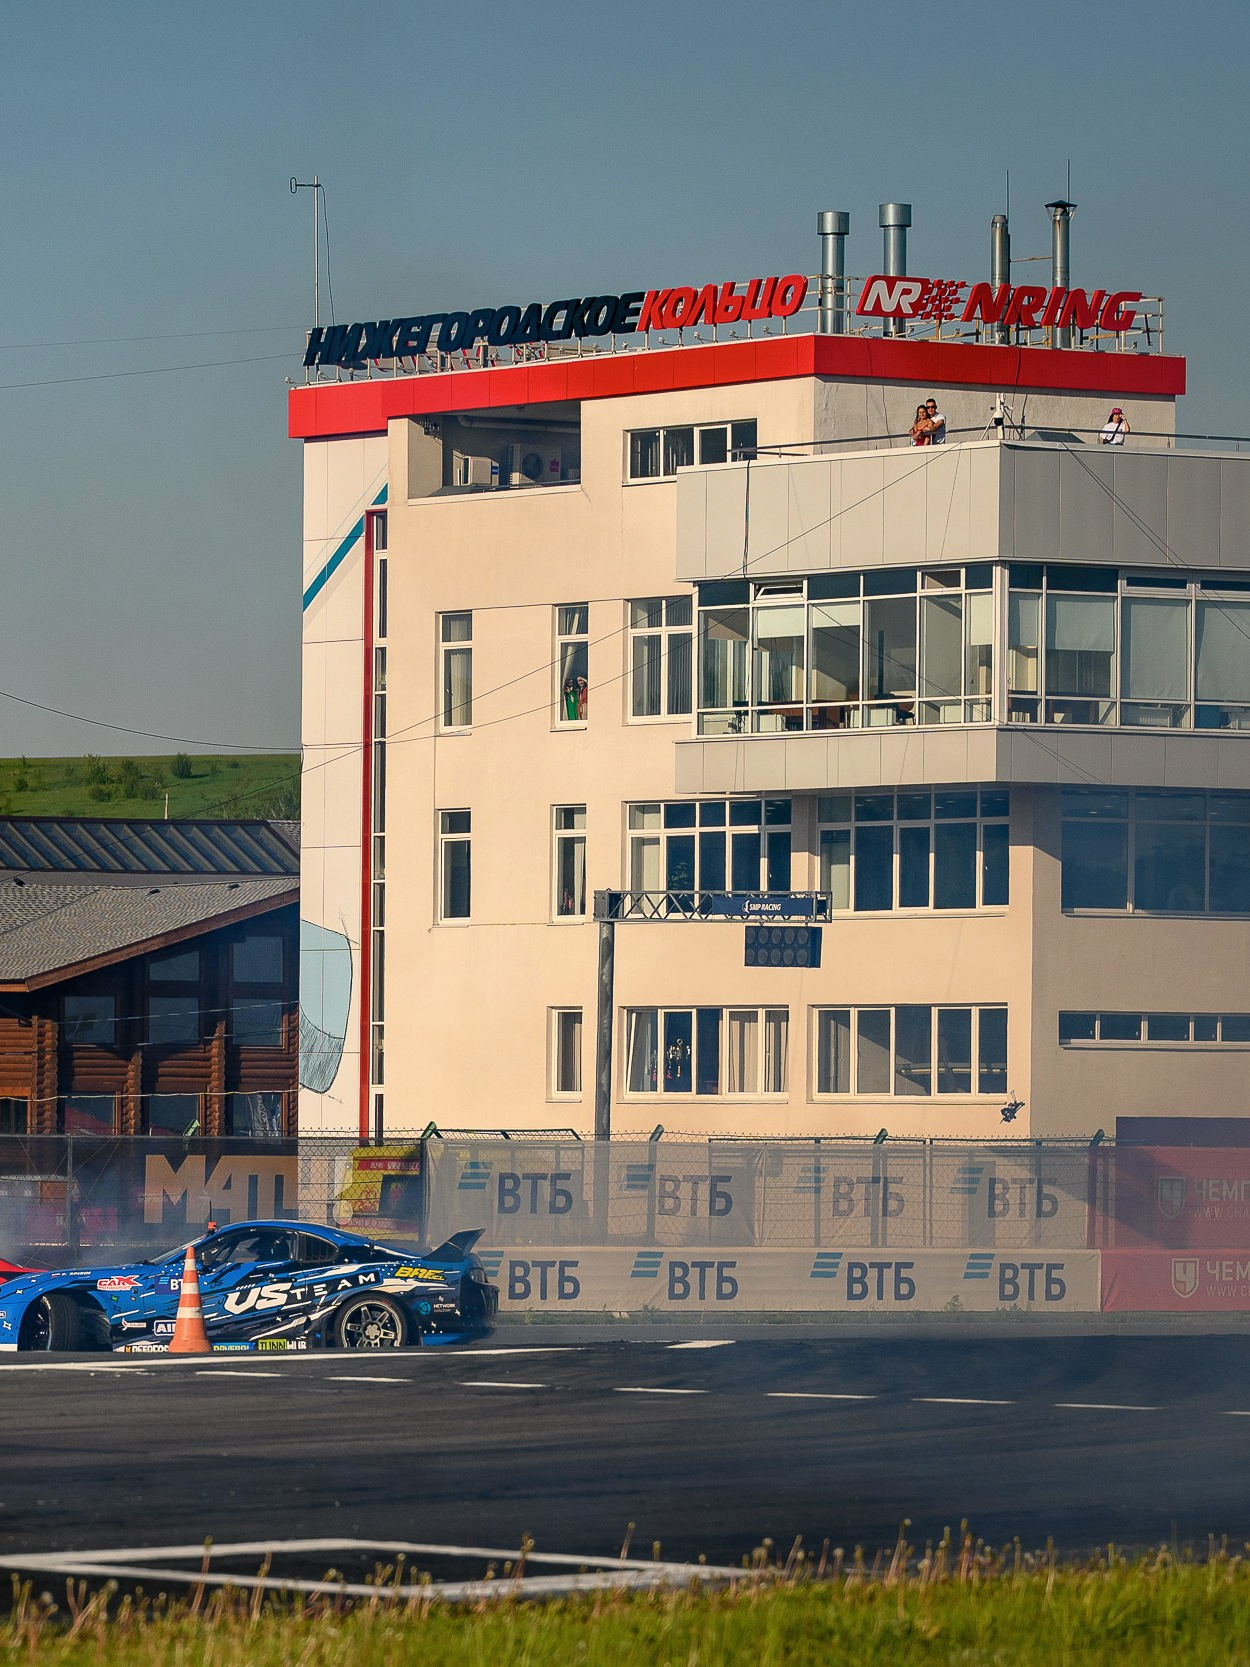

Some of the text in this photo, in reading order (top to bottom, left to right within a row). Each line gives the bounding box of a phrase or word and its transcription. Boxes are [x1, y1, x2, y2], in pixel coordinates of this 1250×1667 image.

[303, 274, 810, 367] НИЖЕГОРОДСКОЕ КОЛЬЦО
[960, 281, 1144, 331] NRING
[749, 903, 782, 911] SMP RACING
[497, 1171, 574, 1215] ВТБ
[657, 1174, 733, 1217] ВТБ
[831, 1175, 906, 1218] ВТБ
[987, 1176, 1059, 1219] ВТБ
[507, 1259, 581, 1301] ВТБ
[667, 1260, 739, 1301] ВТБ
[846, 1261, 917, 1301] ВТБ
[998, 1262, 1067, 1302] ВТБ
